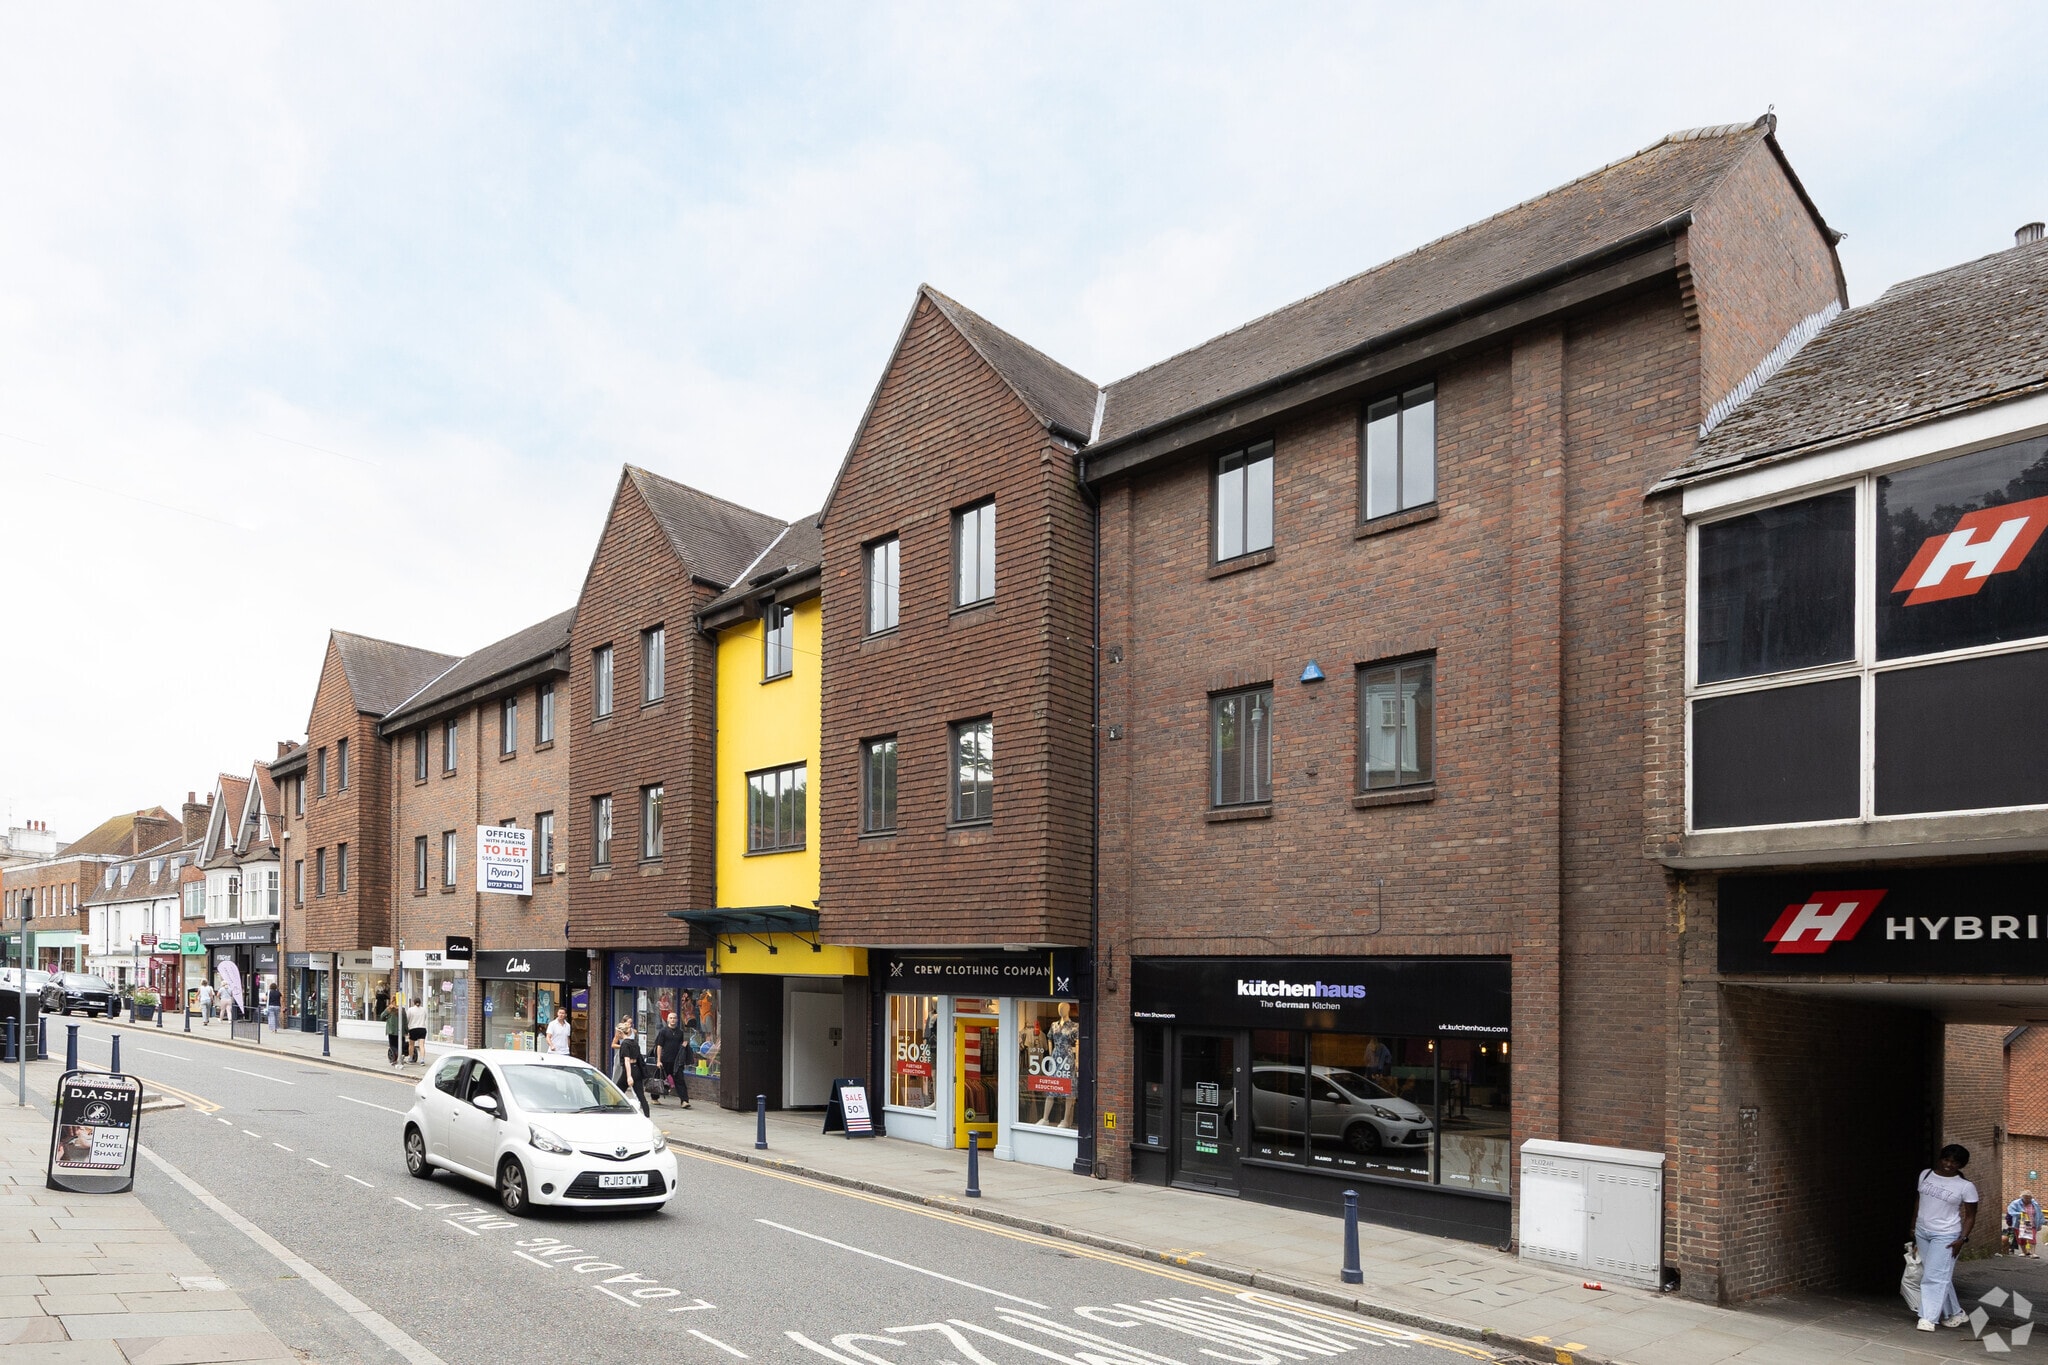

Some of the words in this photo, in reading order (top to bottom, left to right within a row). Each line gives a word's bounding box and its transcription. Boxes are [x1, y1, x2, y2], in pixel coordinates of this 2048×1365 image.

[486, 830, 526, 840] OFFICES
[484, 845, 500, 854] TO
[505, 847, 527, 857] LET
[491, 867, 512, 878] Ryan
[1886, 914, 2048, 941] HYBRI
[506, 958, 530, 972] Clarks
[634, 964, 663, 976] CANCER
[665, 964, 704, 976] RESEARCH
[914, 966, 941, 974] CREW
[946, 966, 999, 975] CLOTHING
[1004, 966, 1050, 976] COMPAN
[1237, 980, 1366, 998] kütchenhaus
[1275, 1001, 1310, 1009] German
[1312, 1002, 1341, 1010] Kitchen
[898, 1042, 931, 1061] 50%
[1029, 1055, 1070, 1076] 50%
[71, 1088, 129, 1101] D.A.S.H
[1106, 1114, 1114, 1127] H
[604, 1176, 624, 1185] RJ13
[426, 1202, 519, 1230] ONLY
[515, 1237, 717, 1313] LOADING
